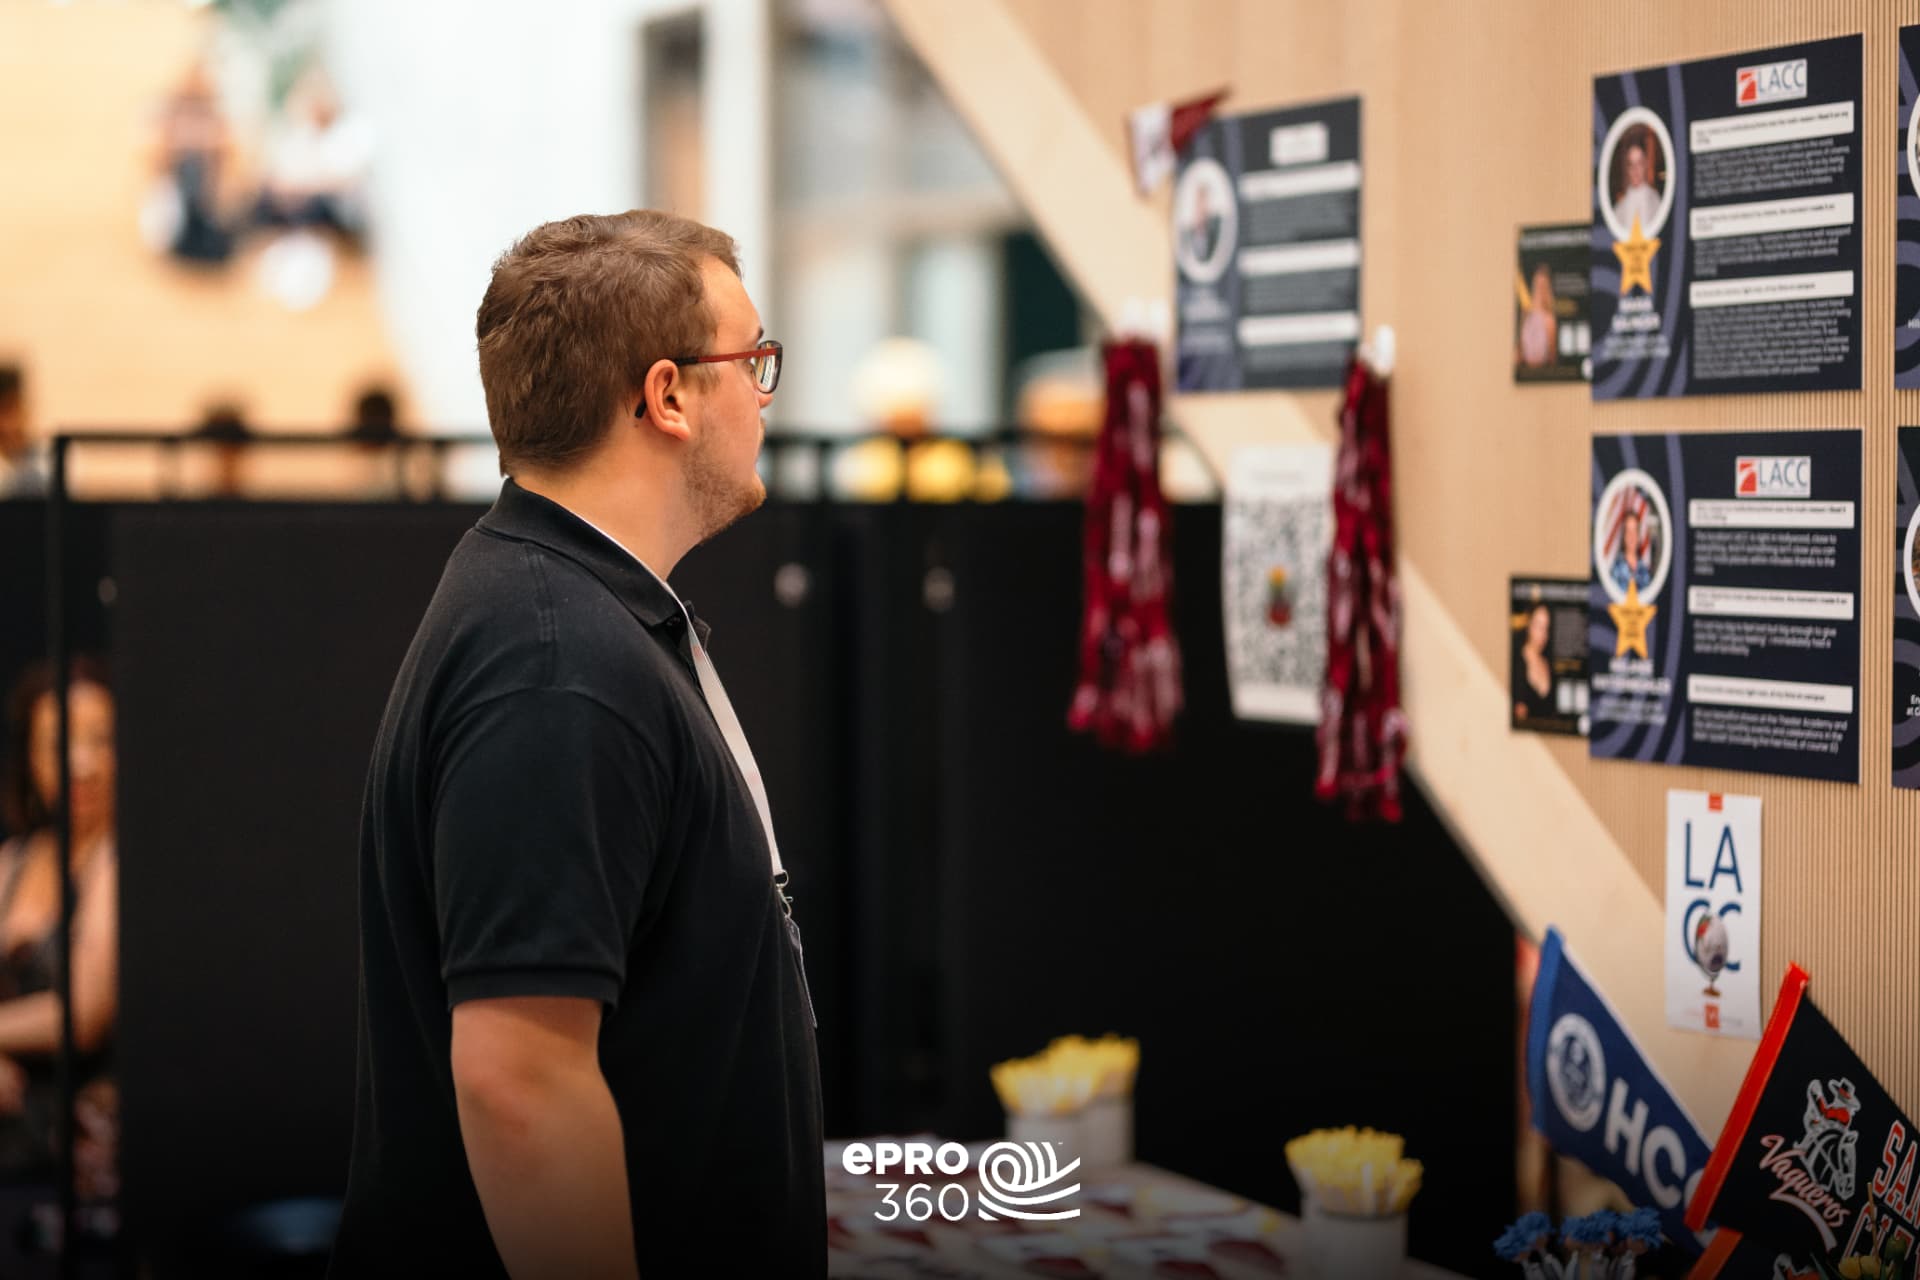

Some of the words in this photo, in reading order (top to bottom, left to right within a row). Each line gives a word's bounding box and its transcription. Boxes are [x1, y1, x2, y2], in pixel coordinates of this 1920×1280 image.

[1757, 62, 1806, 92] LACC
[1758, 459, 1808, 488] LACC
[1759, 1134, 1851, 1229] Vaqueros
